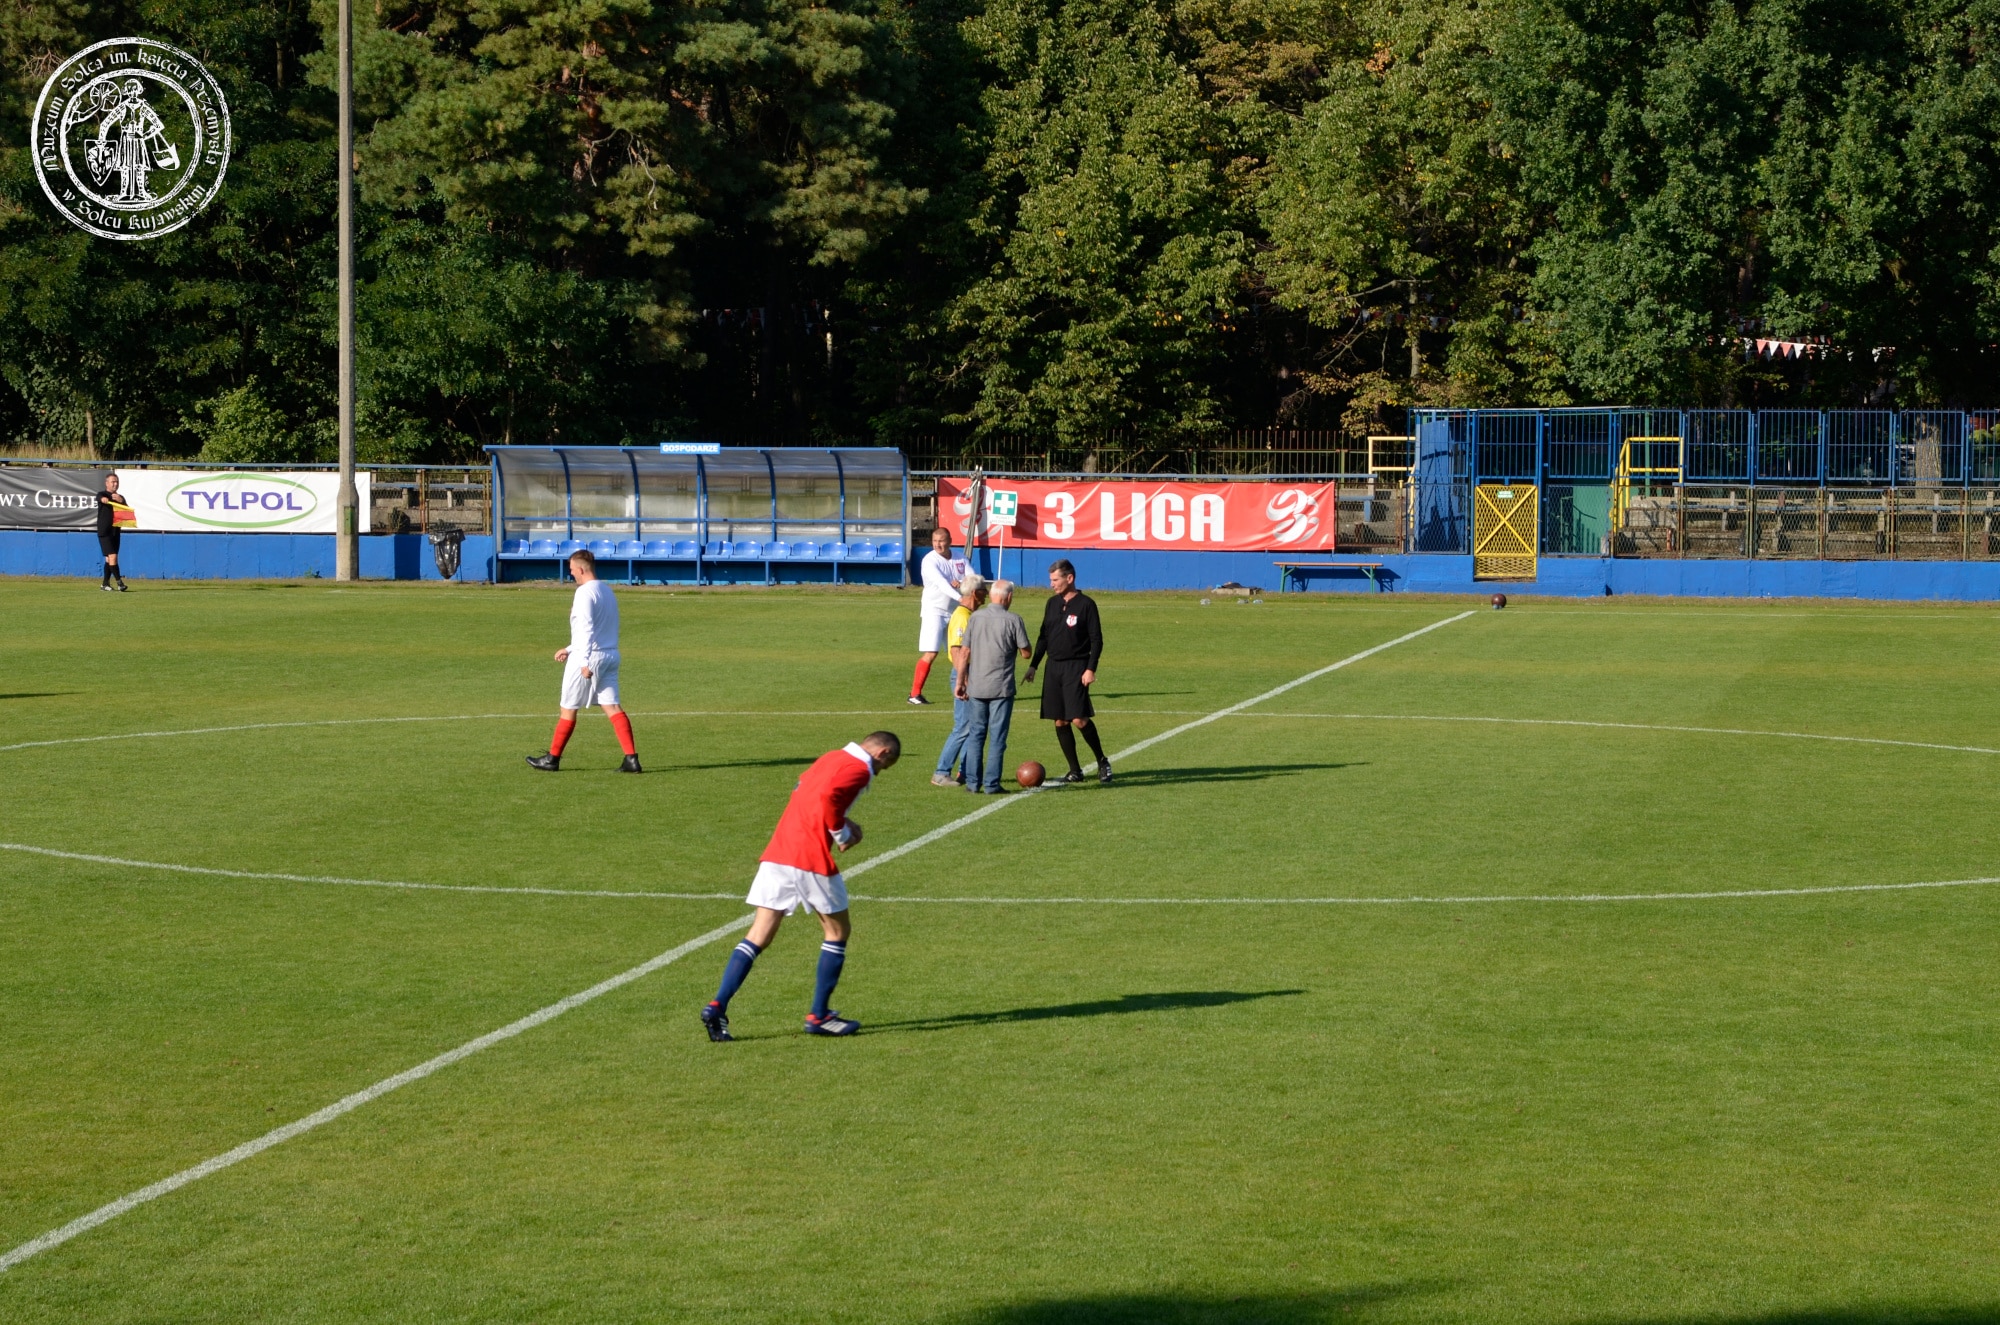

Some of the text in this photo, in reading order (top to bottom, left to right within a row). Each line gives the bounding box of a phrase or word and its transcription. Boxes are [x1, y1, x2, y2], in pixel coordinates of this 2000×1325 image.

[662, 444, 719, 453] GOSPODARZE
[181, 490, 303, 511] TYLPOL
[1043, 491, 1225, 542] 3 LIGA
